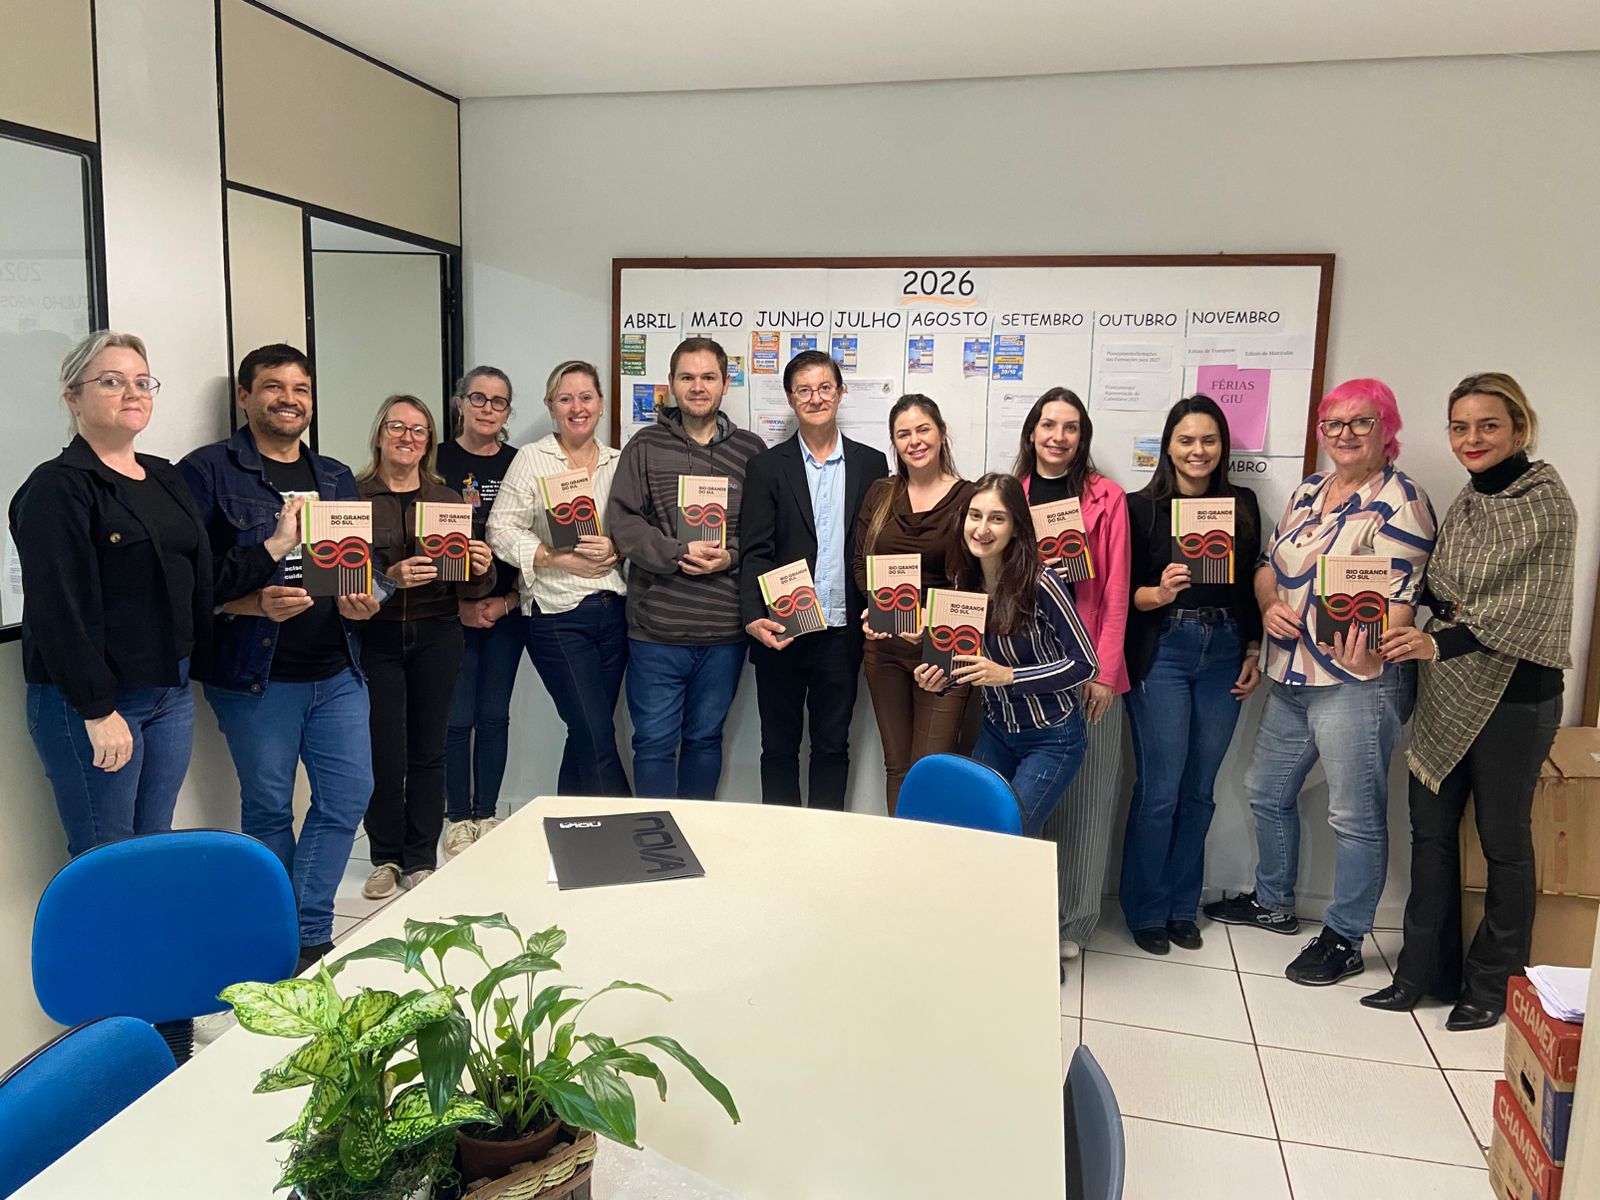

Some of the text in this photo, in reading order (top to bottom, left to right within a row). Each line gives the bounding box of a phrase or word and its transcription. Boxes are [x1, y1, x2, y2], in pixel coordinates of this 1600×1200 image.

[902, 270, 975, 296] 2026
[624, 313, 677, 329] ABRIL
[690, 311, 743, 328] MAIO
[755, 311, 825, 328] JUNHO
[834, 312, 901, 328] JULHO
[911, 311, 988, 327] AGOSTO
[1000, 313, 1084, 327] SETEMBRO
[1099, 313, 1178, 327] OUTUBRO
[1191, 311, 1281, 324] NOVEMBRO
[1211, 378, 1255, 391] FÉRIAS
[1220, 394, 1243, 404] GIU
[1228, 460, 1267, 473] MBRO
[1057, 509, 1079, 517] GRANDE
[961, 604, 985, 612] GRANDE
[1512, 989, 1557, 1061] CHAMEX
[1498, 1095, 1545, 1187] CHAMEX
